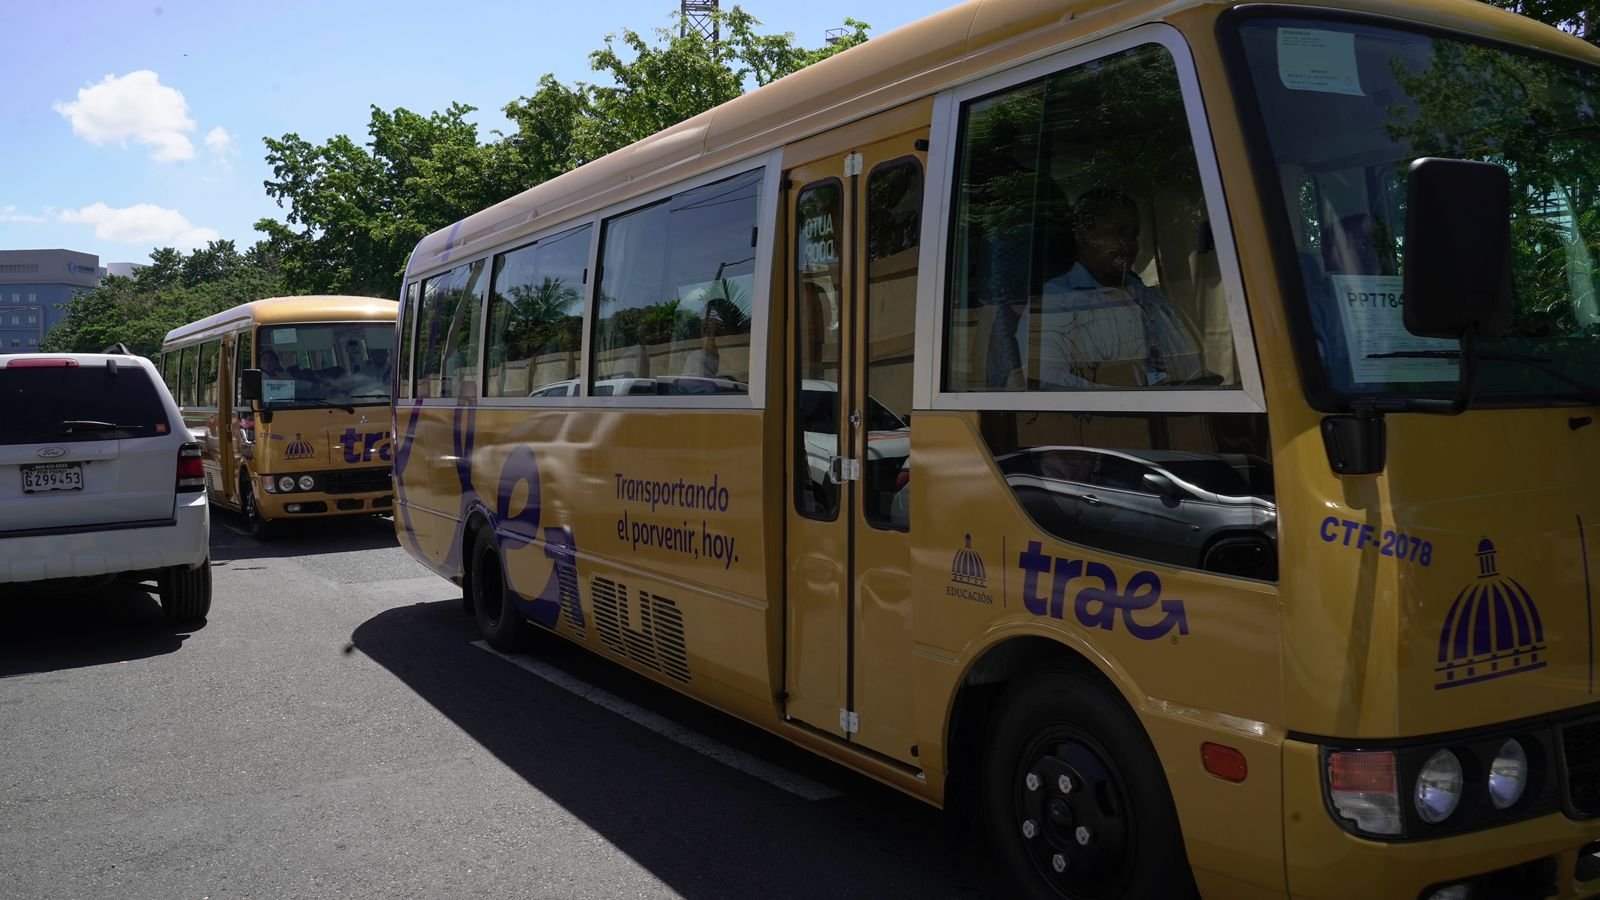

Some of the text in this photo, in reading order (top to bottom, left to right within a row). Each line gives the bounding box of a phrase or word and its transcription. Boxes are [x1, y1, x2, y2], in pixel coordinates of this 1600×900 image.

[614, 473, 729, 512] Transportando
[617, 511, 739, 570] el porvenir, hoy.
[1320, 516, 1433, 567] CTF-2078
[1018, 540, 1189, 640] trae
